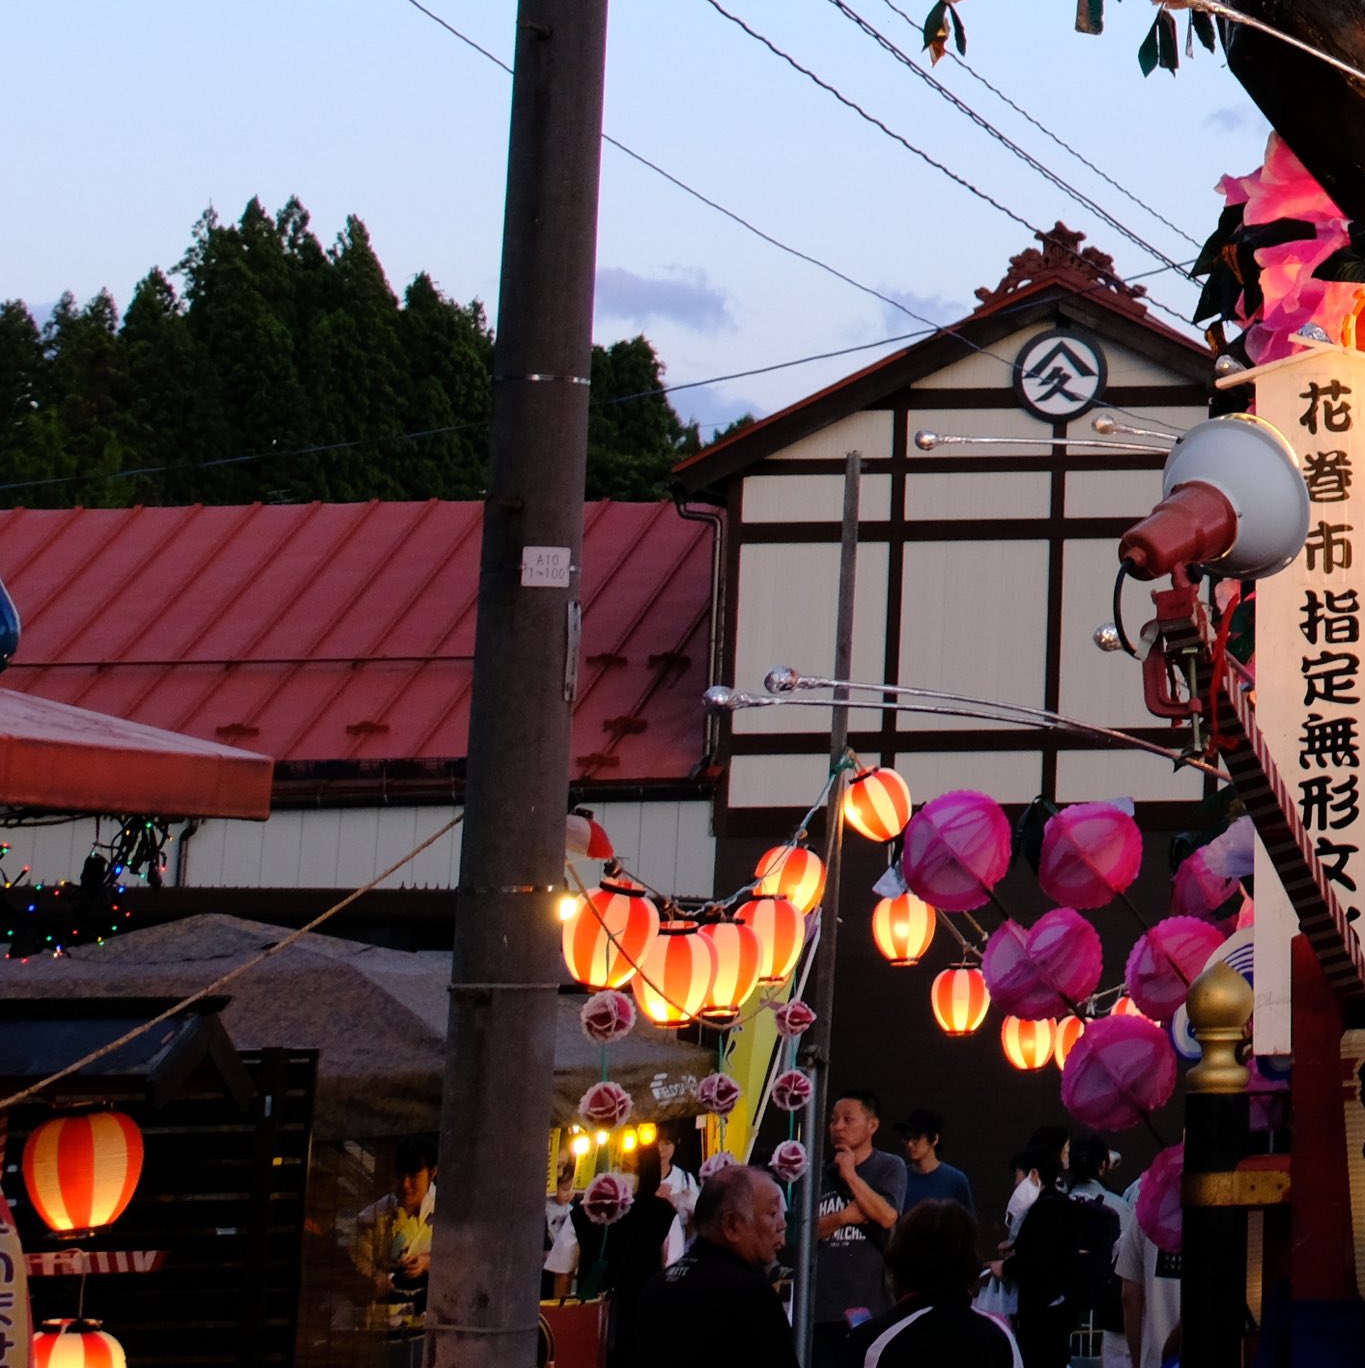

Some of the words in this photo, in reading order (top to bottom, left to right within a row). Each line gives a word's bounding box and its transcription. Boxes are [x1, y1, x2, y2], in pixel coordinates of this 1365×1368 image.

[536, 553, 560, 566] A10
[1299, 379, 1361, 945] 花巻市指定無形文
